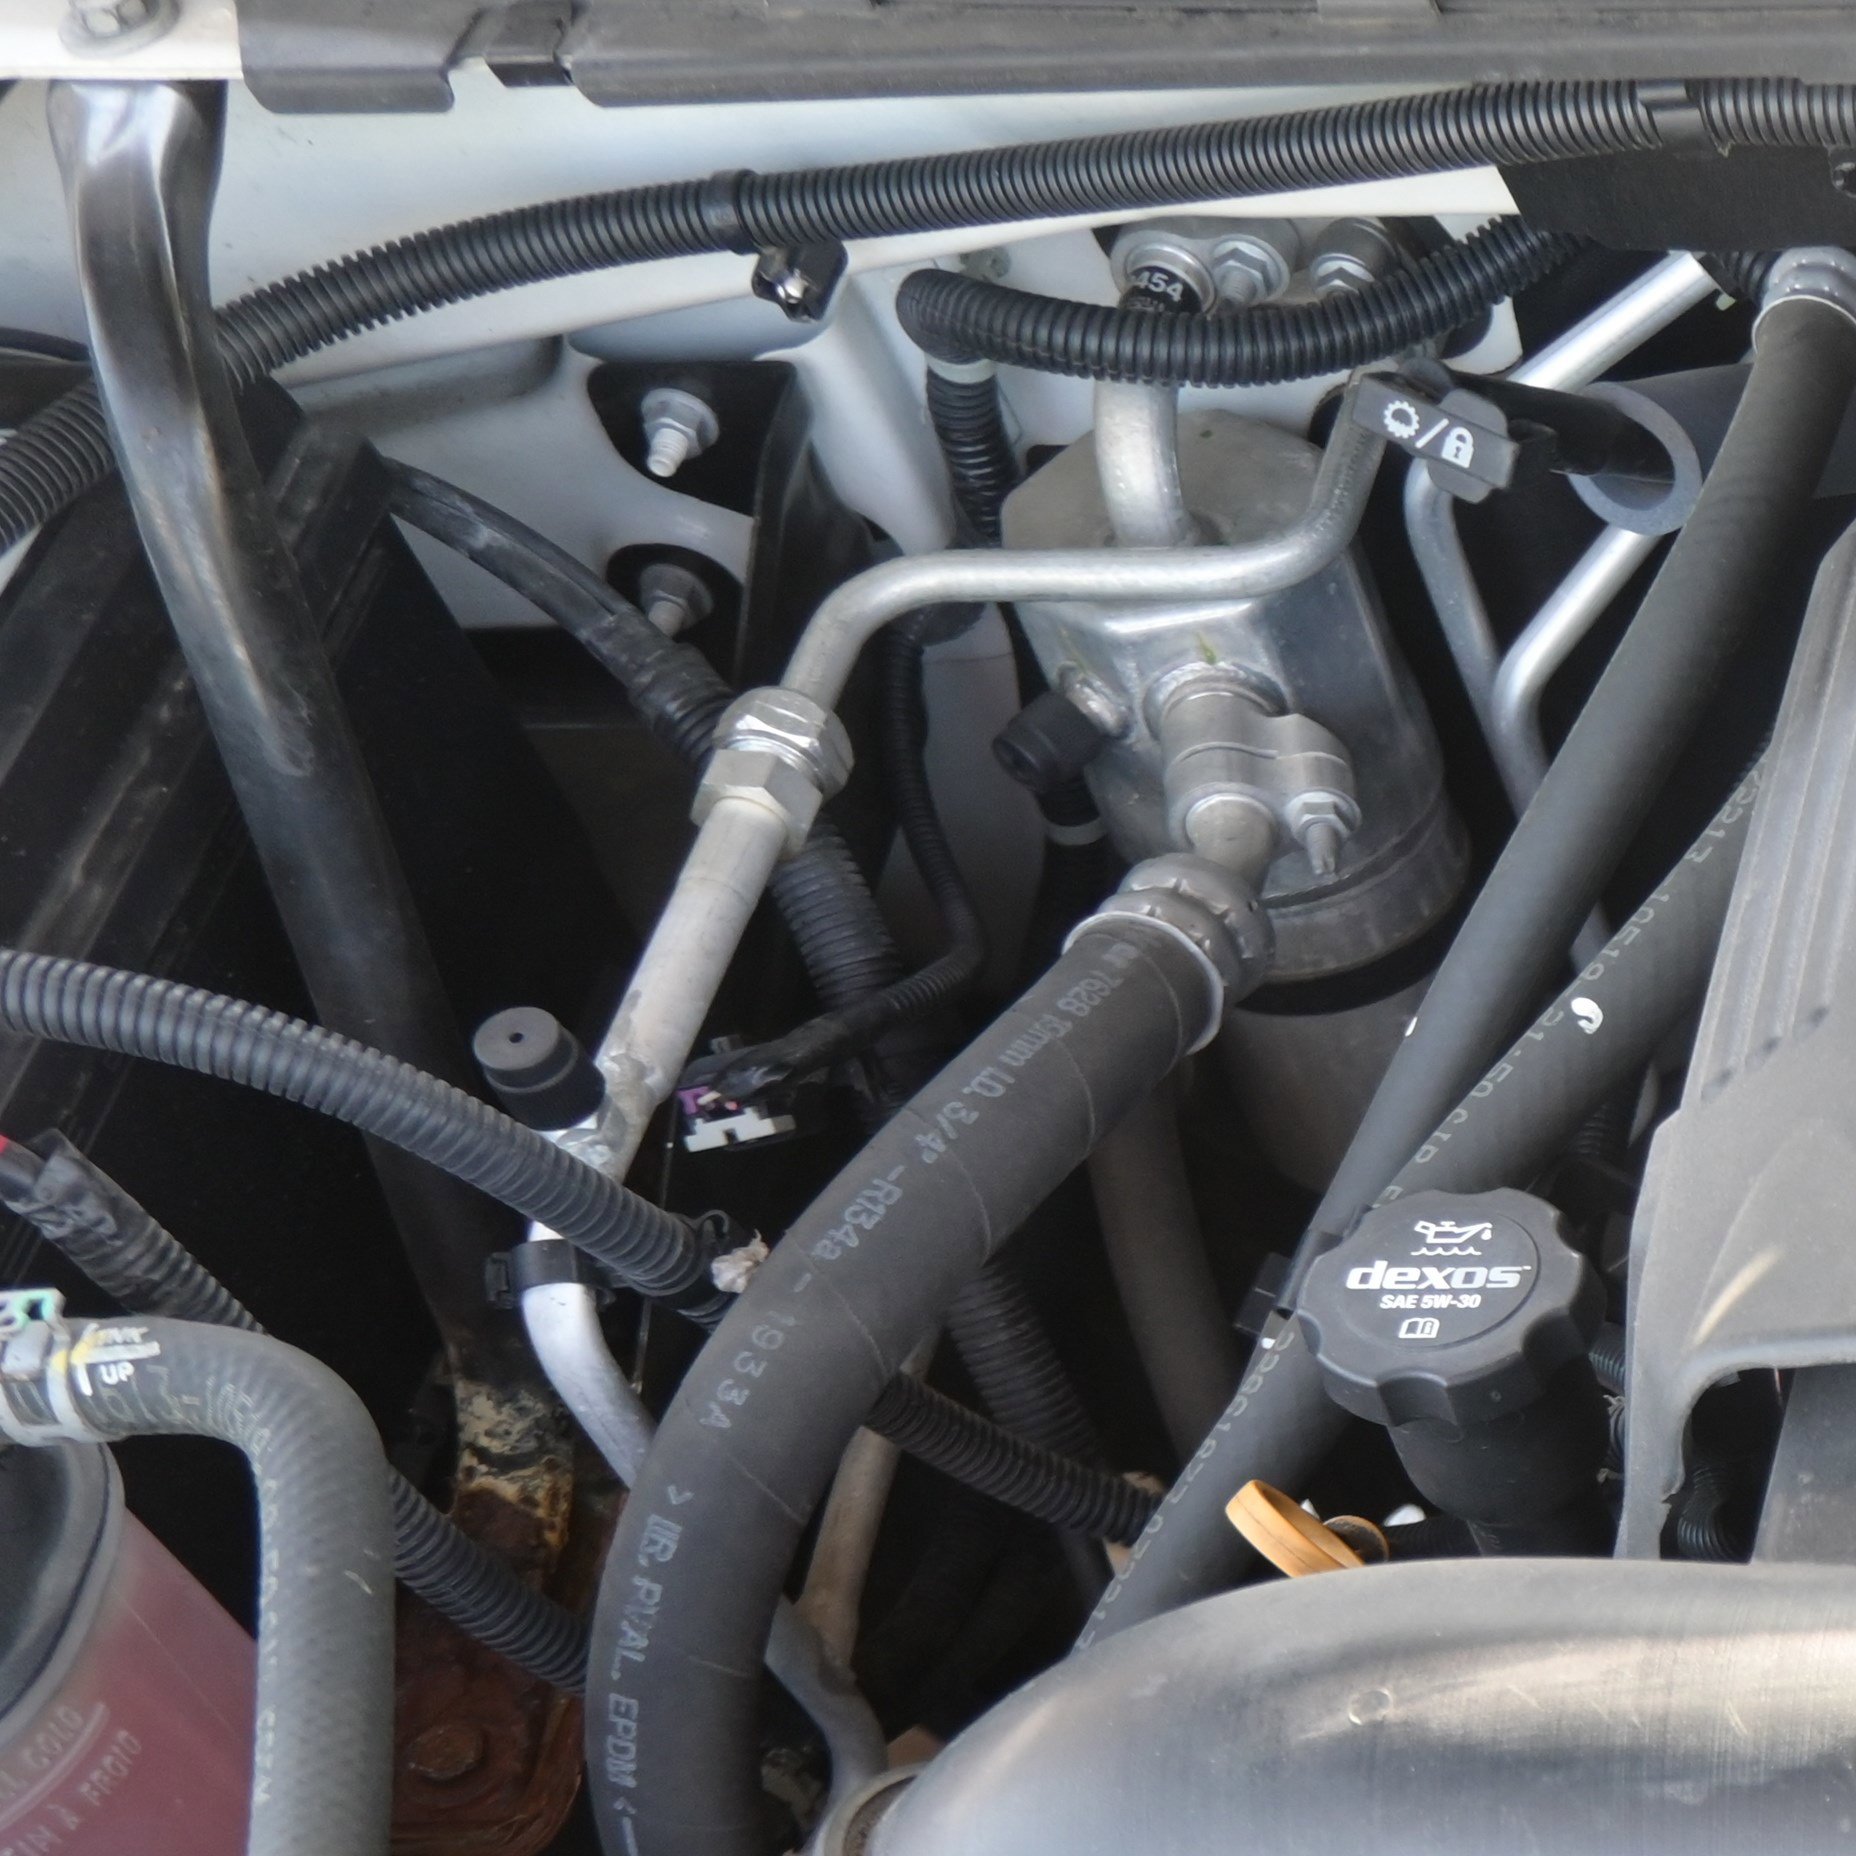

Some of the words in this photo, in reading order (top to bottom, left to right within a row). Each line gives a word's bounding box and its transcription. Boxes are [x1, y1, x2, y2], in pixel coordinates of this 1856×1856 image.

[1345, 1259, 1524, 1291] dexos
[1379, 1294, 1419, 1309] SAE
[1420, 1293, 1483, 1309] 5W-30
[99, 1361, 135, 1385] UP
